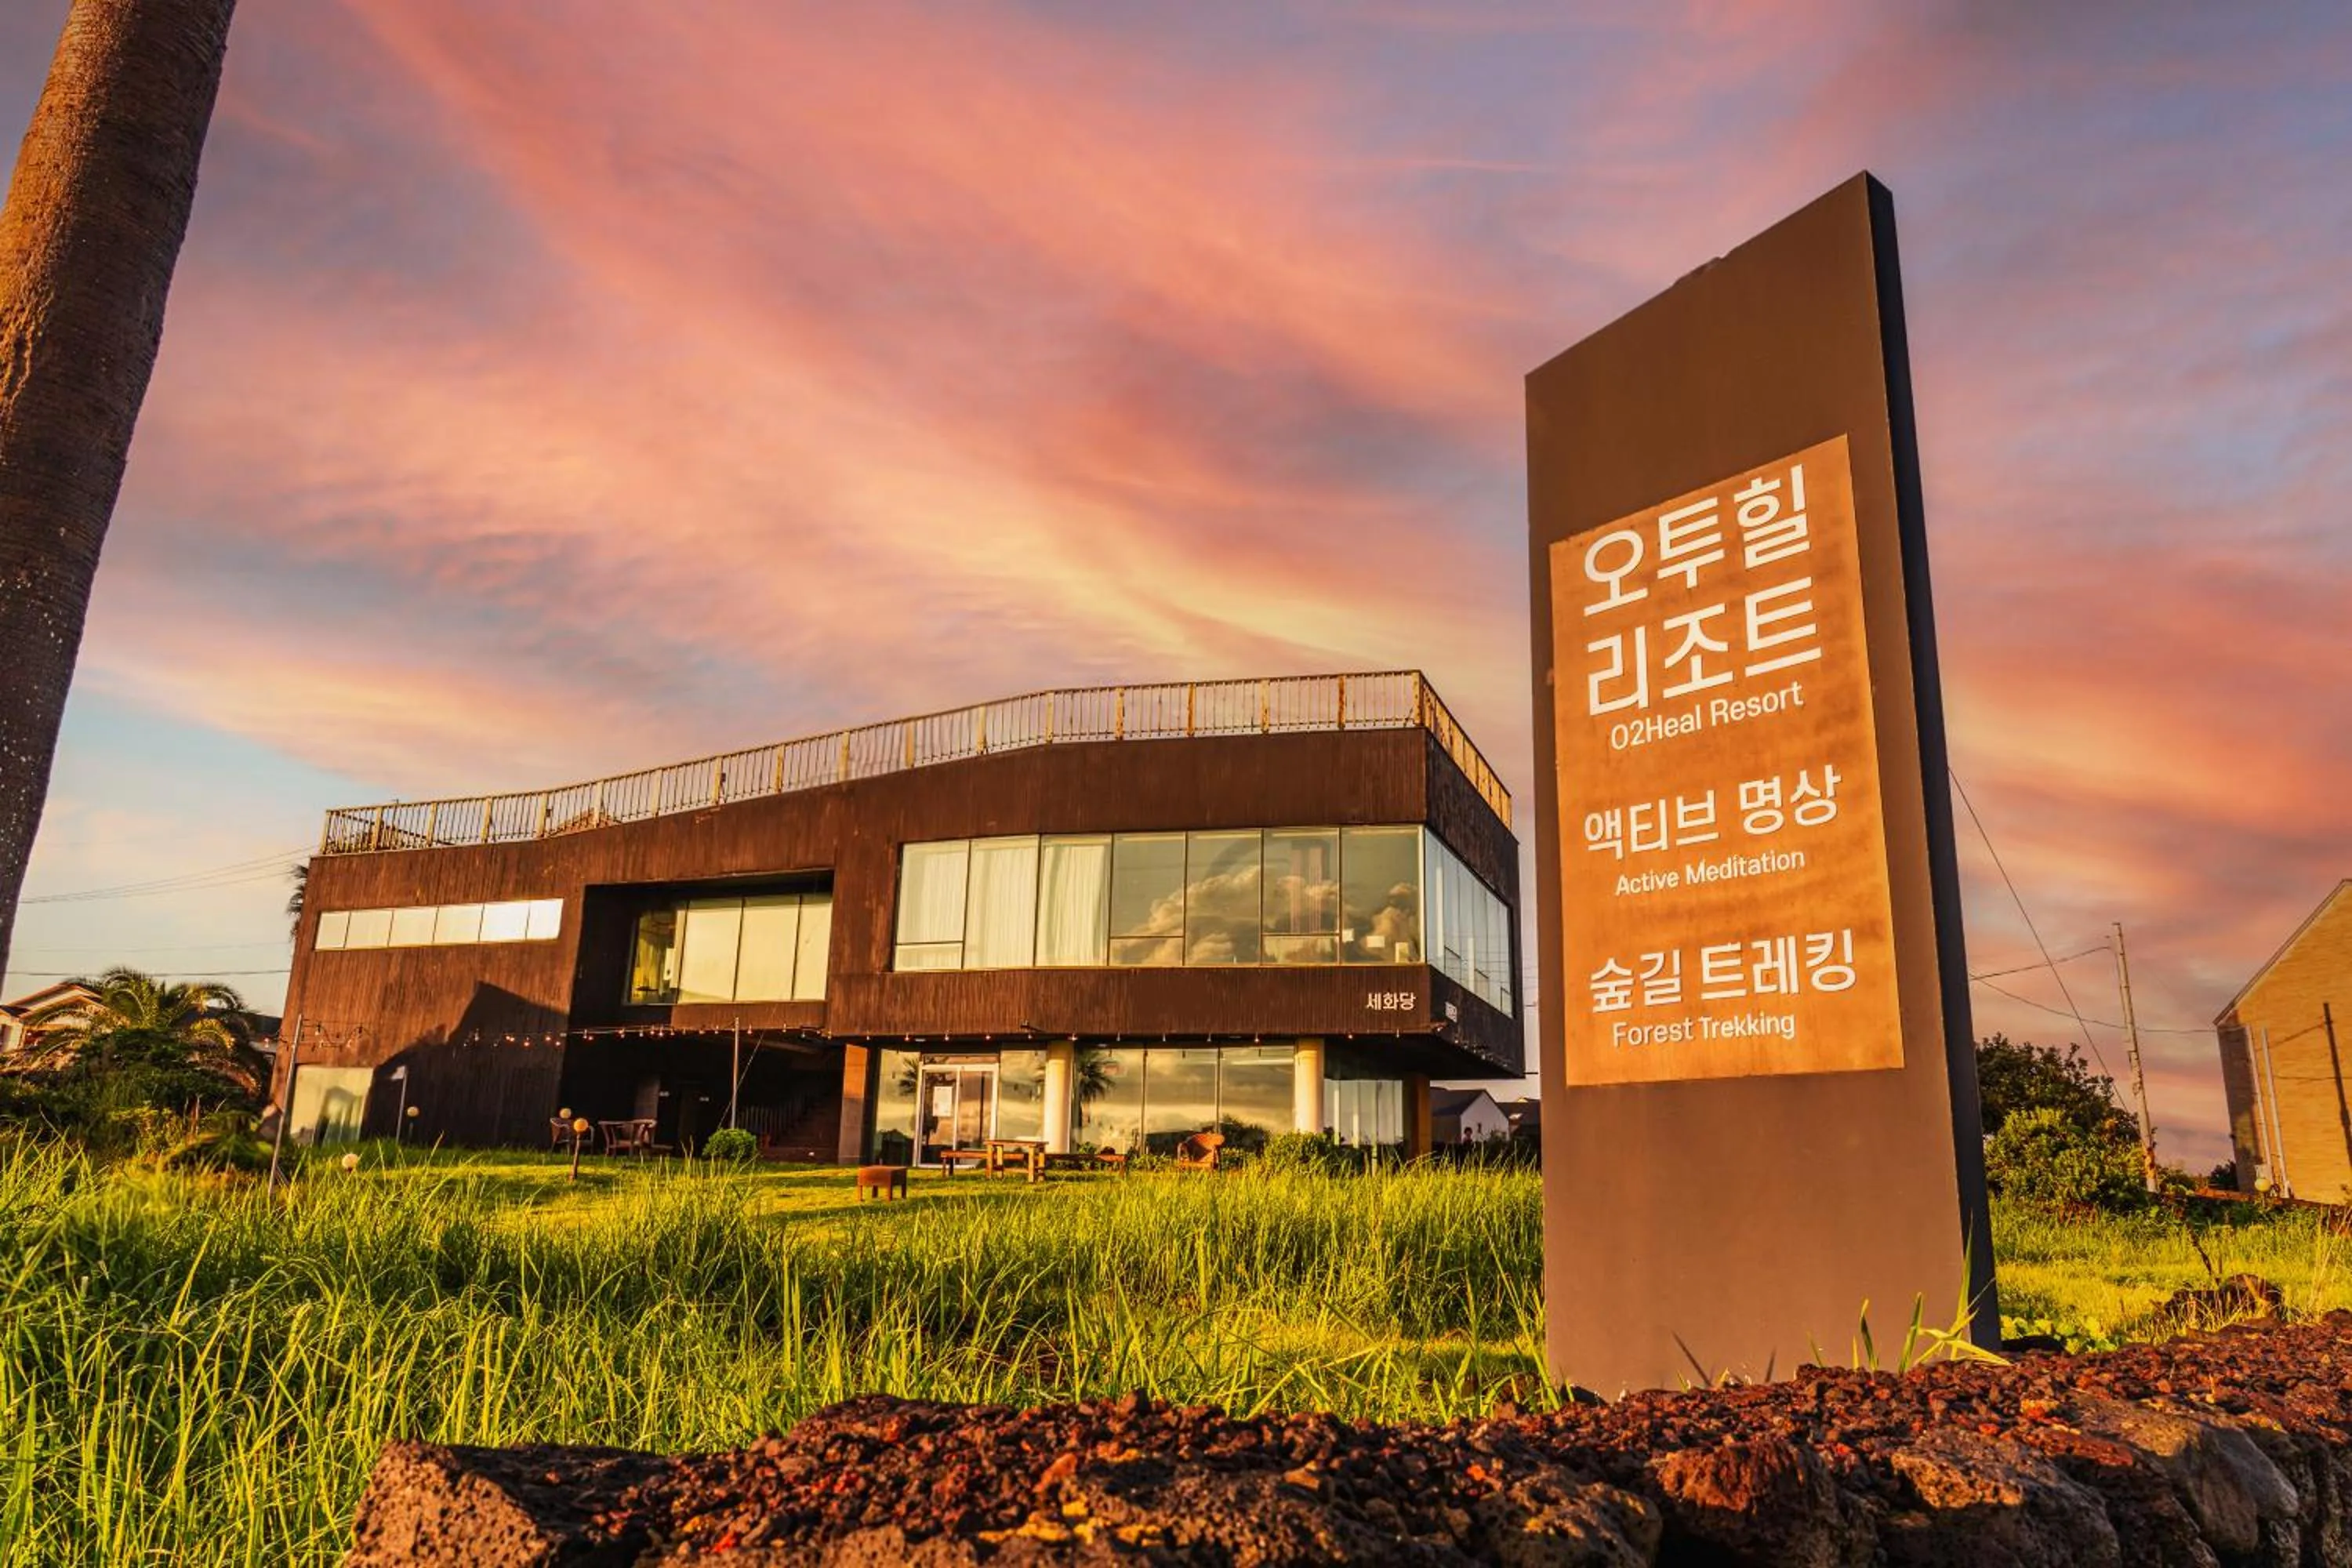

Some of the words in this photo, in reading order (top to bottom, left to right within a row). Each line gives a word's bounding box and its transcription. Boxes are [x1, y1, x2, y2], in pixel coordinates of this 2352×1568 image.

[1584, 464, 1810, 617] 오투힐
[1587, 576, 1821, 716] 리조트
[1611, 705, 1701, 750] O2Heal
[1711, 681, 1804, 726] Resort
[1584, 789, 1719, 859] 액티브
[1739, 764, 1842, 835] 명상
[1615, 871, 1679, 896] Active
[1686, 850, 1806, 885] Meditation
[1366, 992, 1416, 1011] 세화당
[1590, 949, 1682, 1014] 숲길
[1700, 928, 1857, 1000] 트레킹
[1613, 1018, 1694, 1047] Forest
[1699, 1011, 1795, 1040] Trekking
